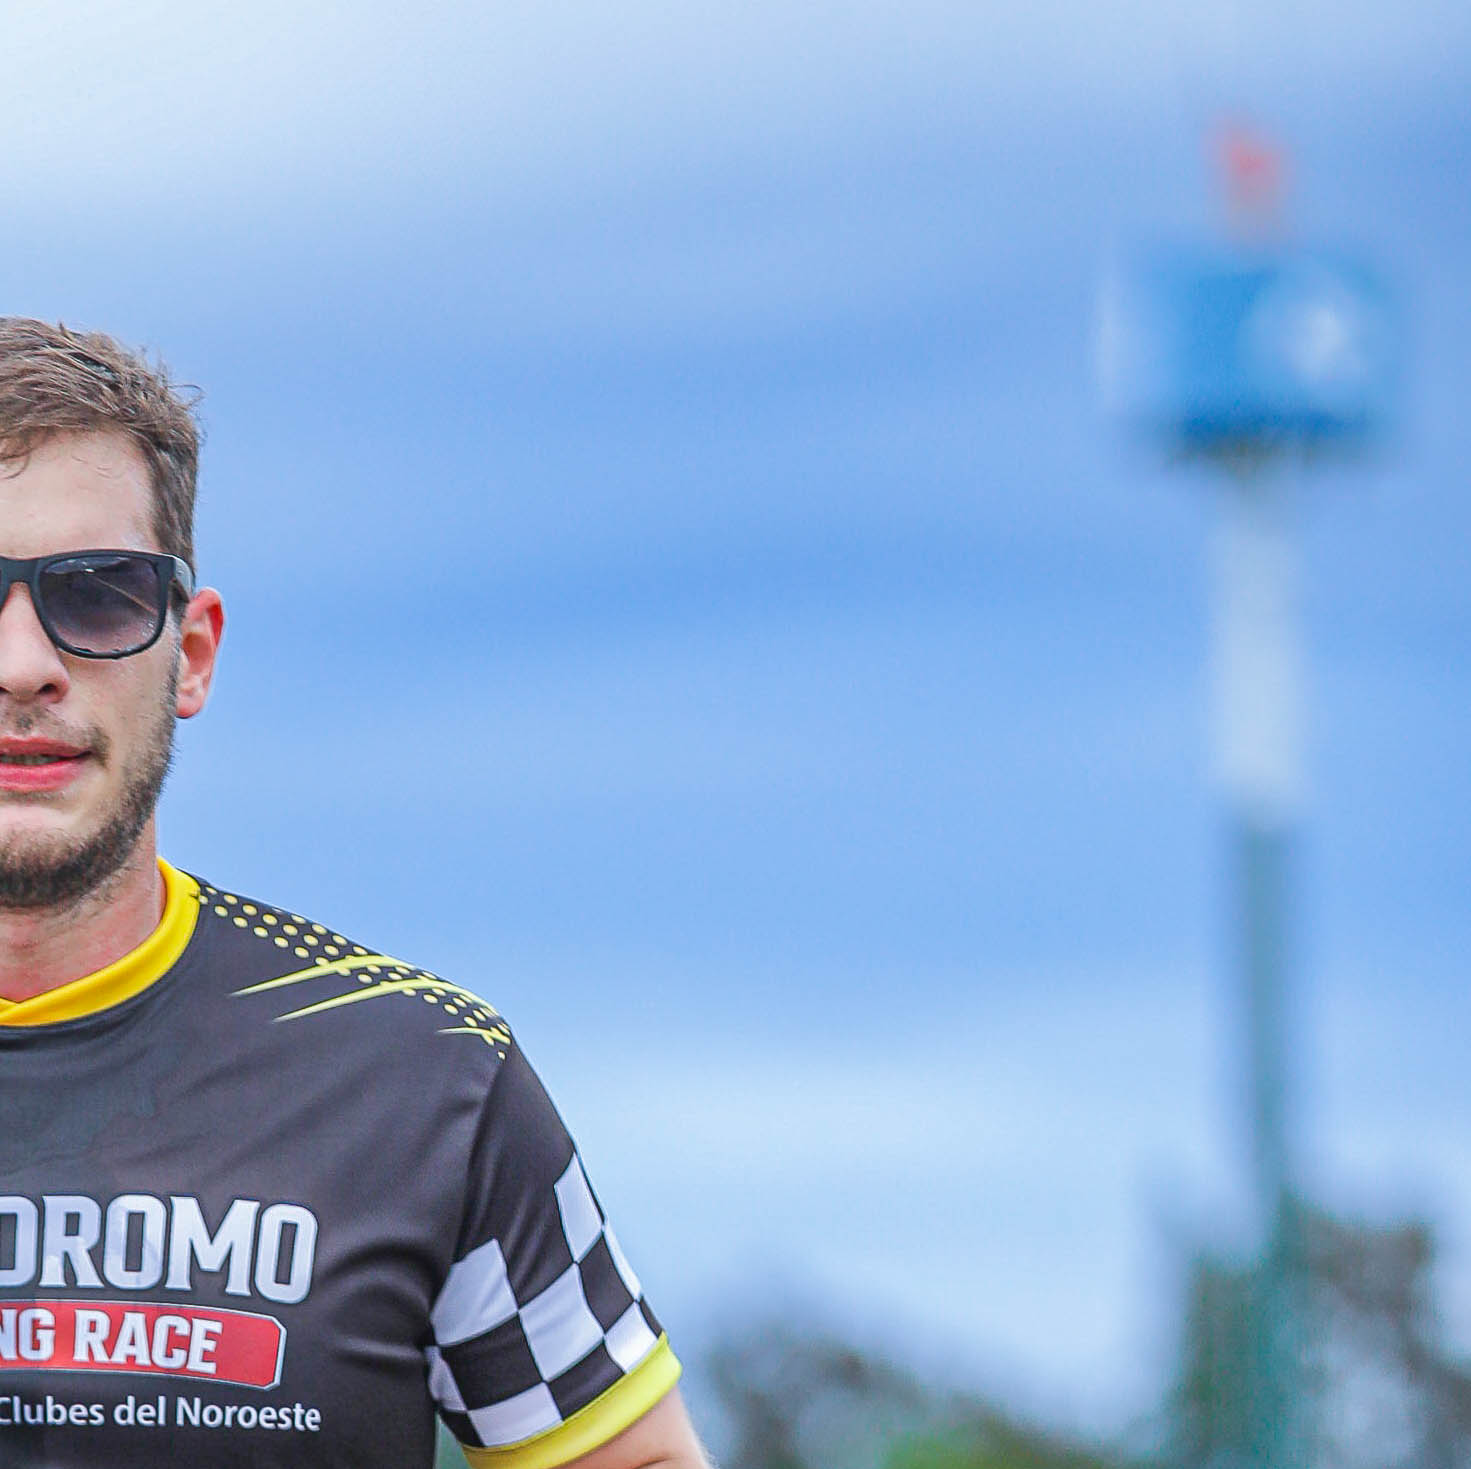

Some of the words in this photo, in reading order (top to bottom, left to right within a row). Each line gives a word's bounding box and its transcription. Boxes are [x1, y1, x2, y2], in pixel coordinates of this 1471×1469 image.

[73, 1308, 224, 1374] RACE
[114, 1396, 166, 1426] del
[176, 1397, 322, 1431] Noroeste
